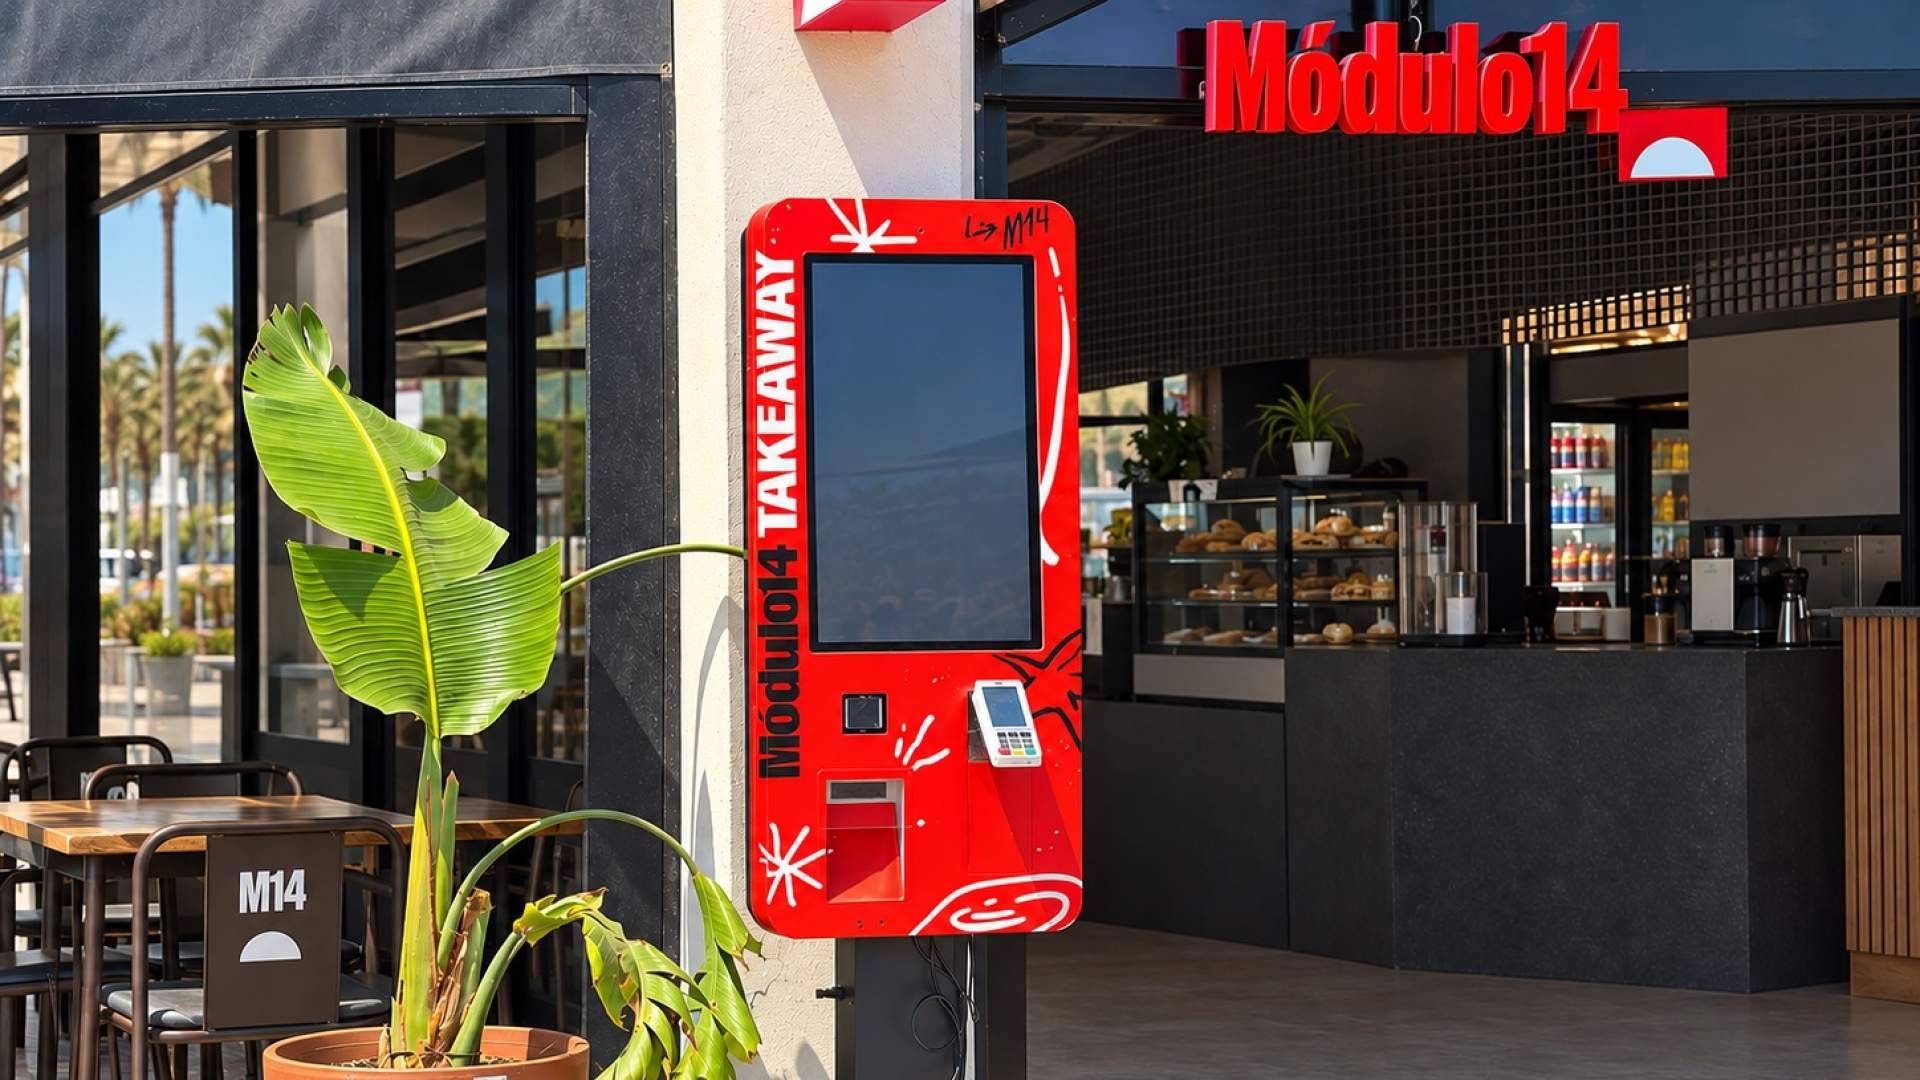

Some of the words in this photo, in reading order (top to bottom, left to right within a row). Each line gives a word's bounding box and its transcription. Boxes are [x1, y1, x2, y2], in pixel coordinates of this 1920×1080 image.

[1204, 19, 1629, 135] Módulo14
[1003, 204, 1049, 250] M14
[755, 250, 798, 538] TAKEAWAY
[757, 544, 801, 779] Módulo14
[239, 869, 307, 914] M14
